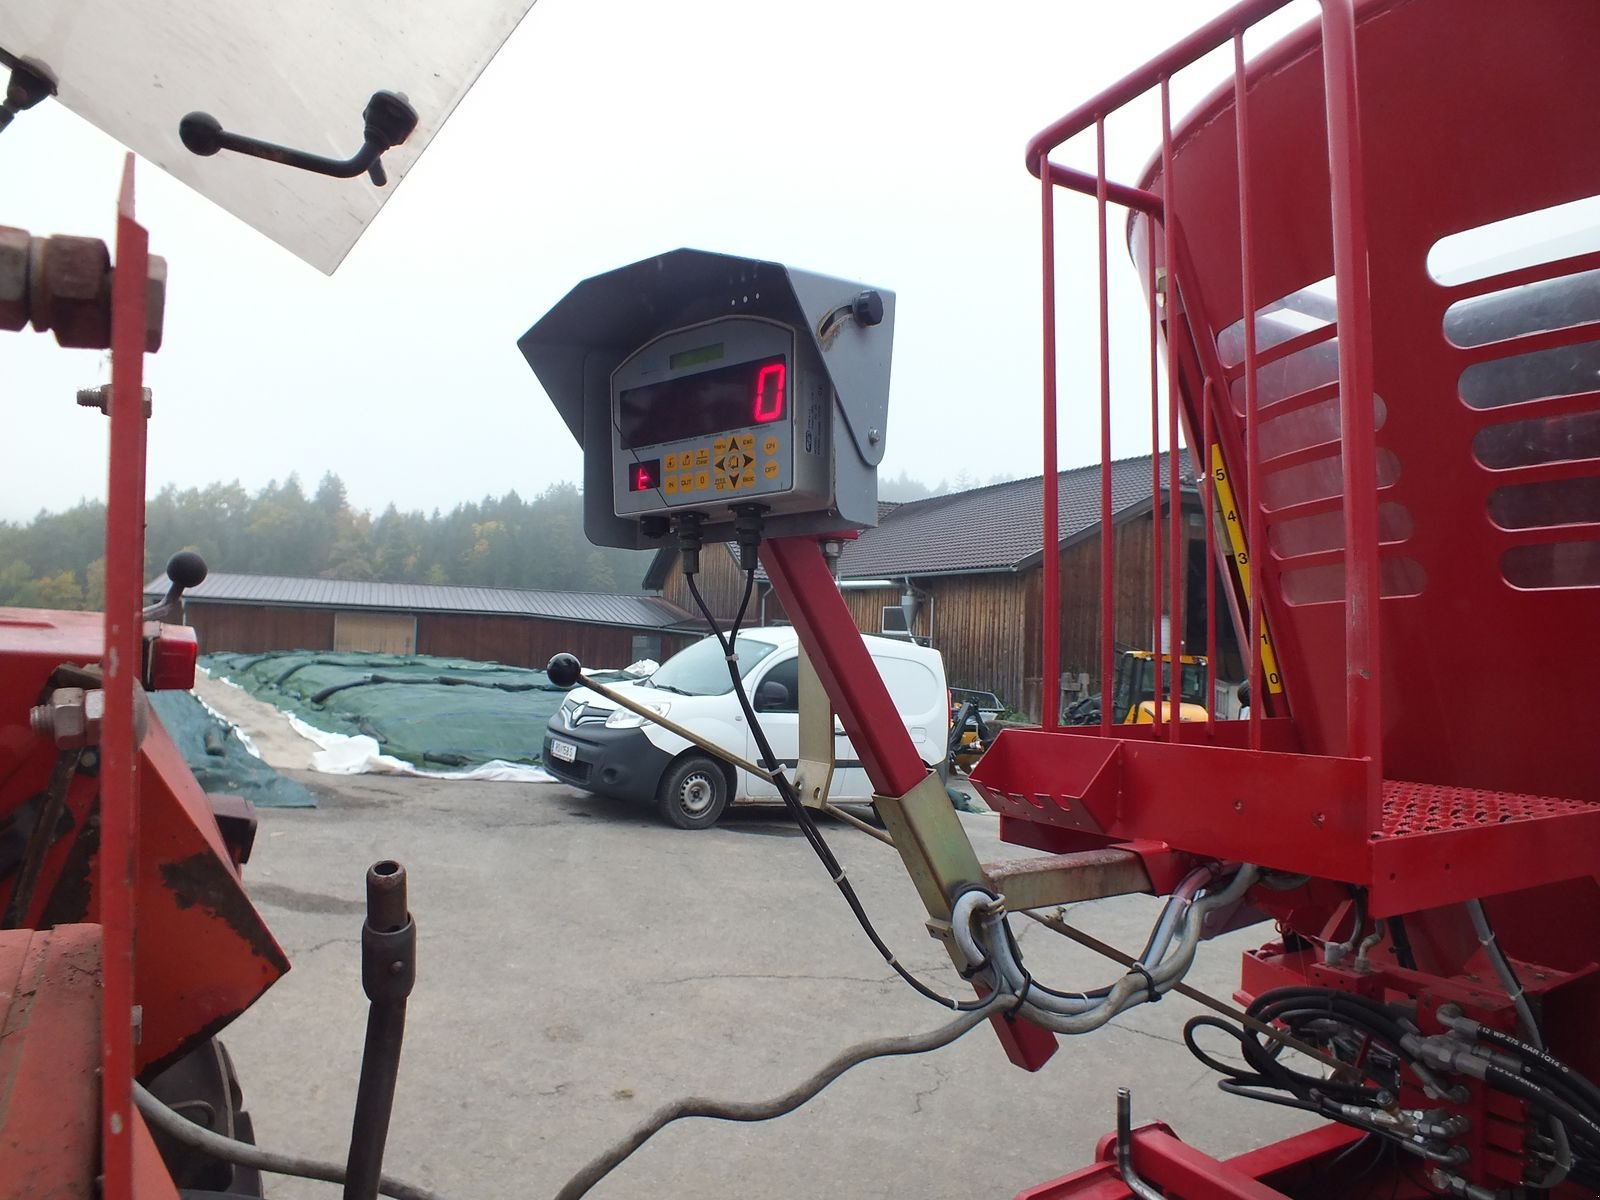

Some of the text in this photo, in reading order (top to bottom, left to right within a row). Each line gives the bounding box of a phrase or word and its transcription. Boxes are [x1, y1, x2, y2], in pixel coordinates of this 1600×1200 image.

[754, 363, 786, 422] 0
[765, 441, 776, 450] ON
[764, 465, 777, 474] OFF
[1215, 468, 1225, 482] 5
[680, 479, 692, 487] OUT
[1227, 509, 1237, 522] 4
[1237, 552, 1249, 565] 3
[1261, 633, 1268, 645] 1
[1269, 672, 1280, 685] 0
[1521, 1043, 1539, 1056] BAR
